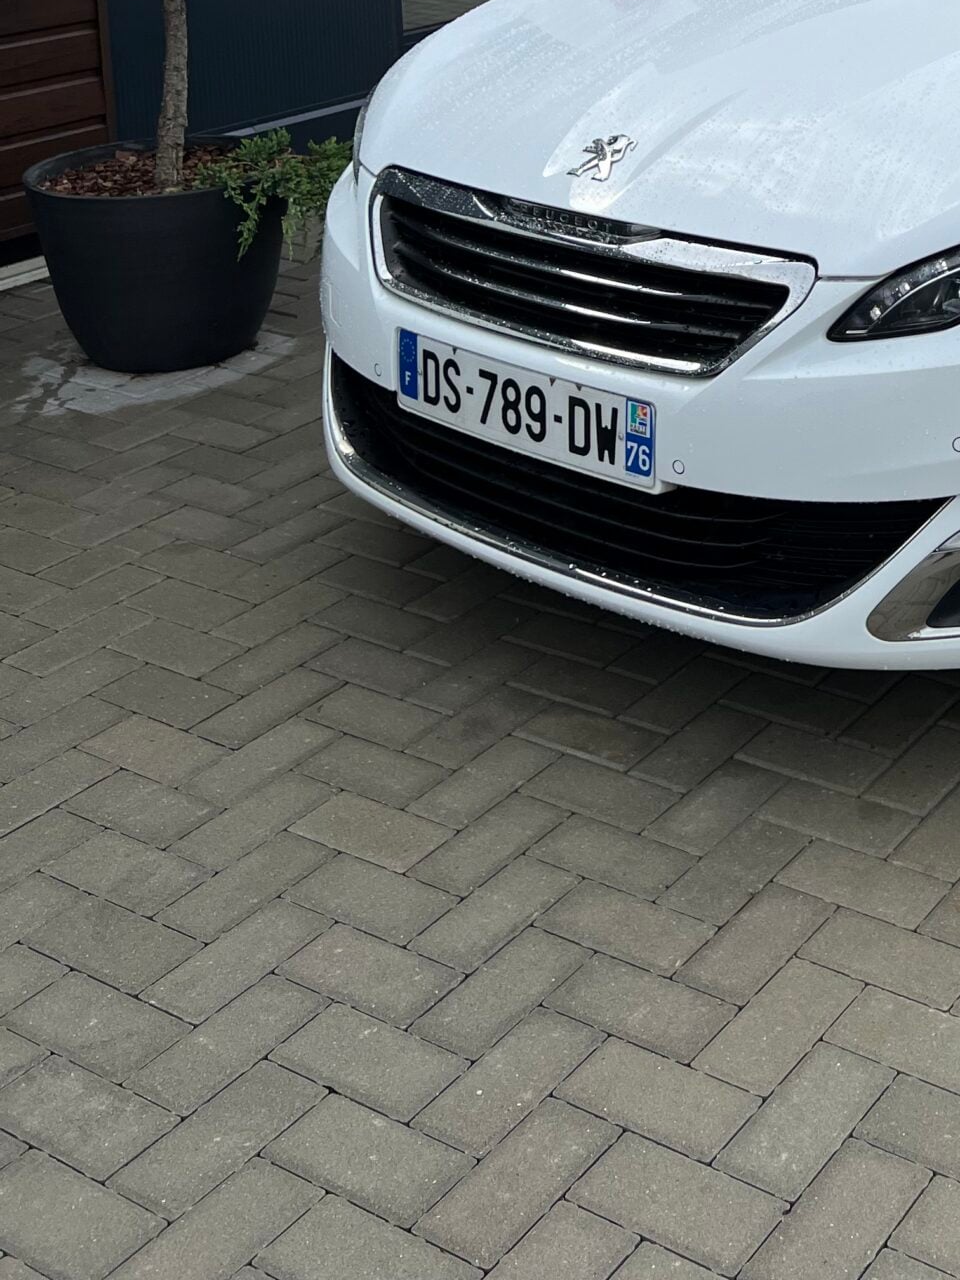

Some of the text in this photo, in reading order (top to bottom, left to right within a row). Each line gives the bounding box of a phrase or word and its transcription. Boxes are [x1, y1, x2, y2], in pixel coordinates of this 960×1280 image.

[404, 371, 412, 386] F
[422, 348, 619, 466] DS-789-DW
[626, 440, 650, 472] 76
